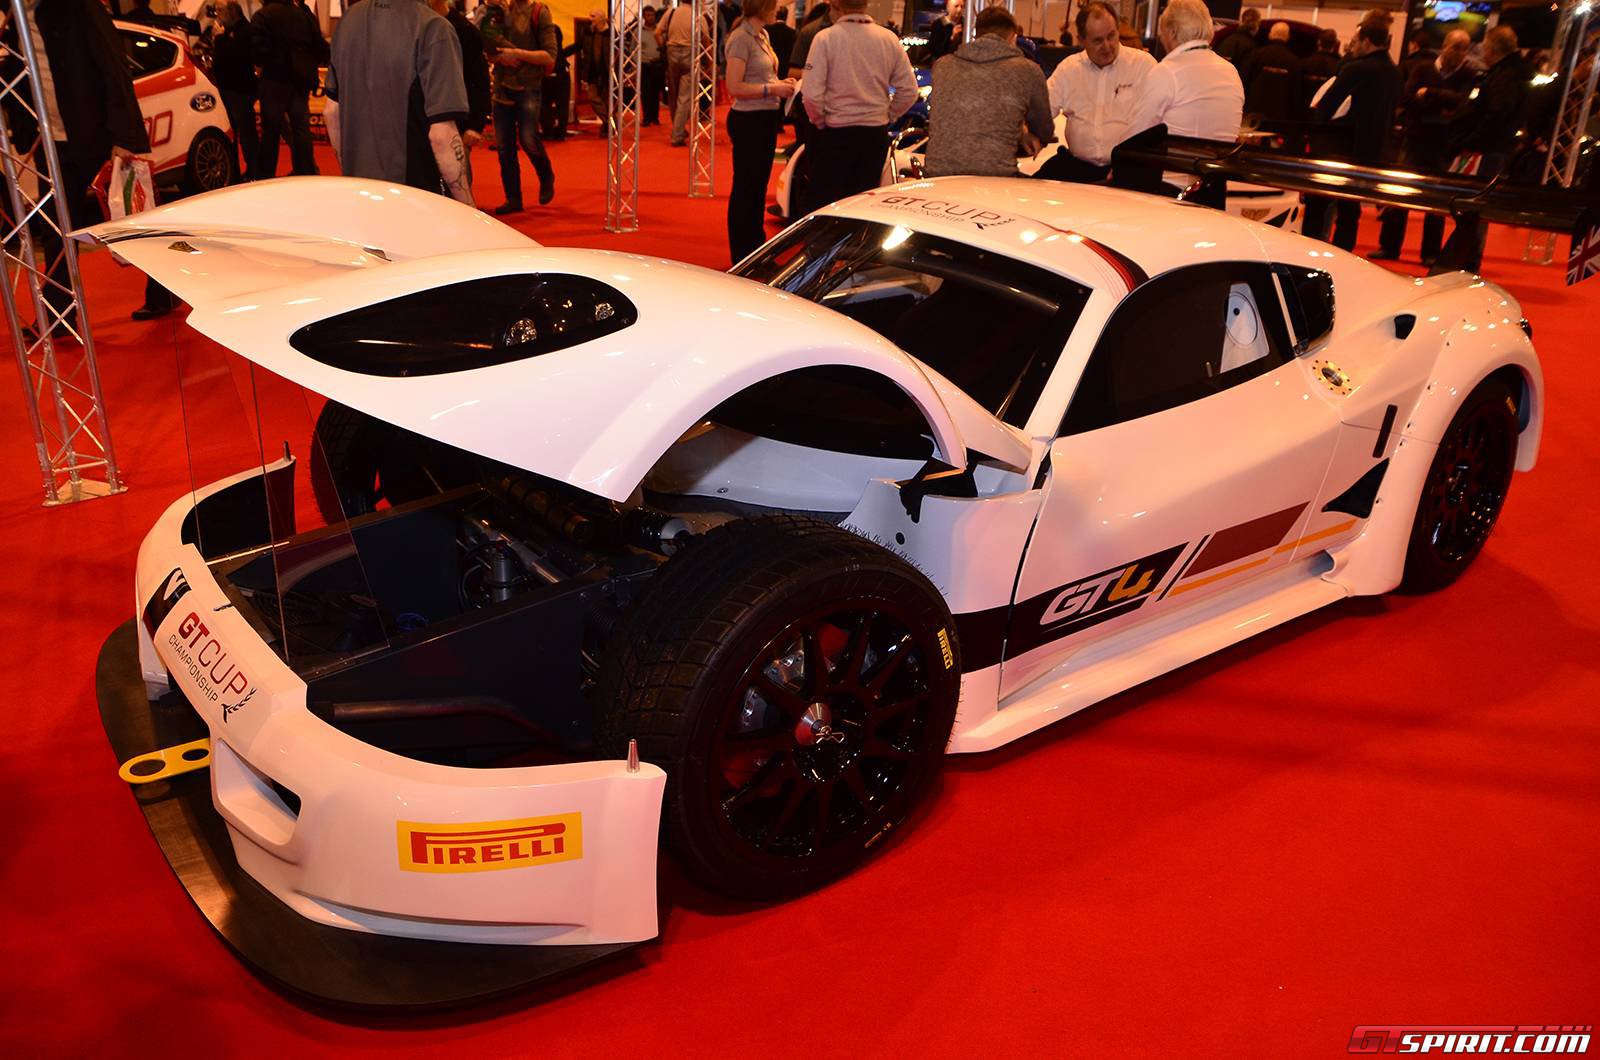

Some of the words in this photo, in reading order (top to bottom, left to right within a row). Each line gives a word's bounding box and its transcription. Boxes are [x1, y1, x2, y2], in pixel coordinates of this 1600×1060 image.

[870, 203, 965, 223] CHAMPIONSHIP
[1039, 563, 1155, 626] GT4
[168, 634, 219, 702] CHAMPIONSHIP
[410, 822, 566, 865] PIRELLI
